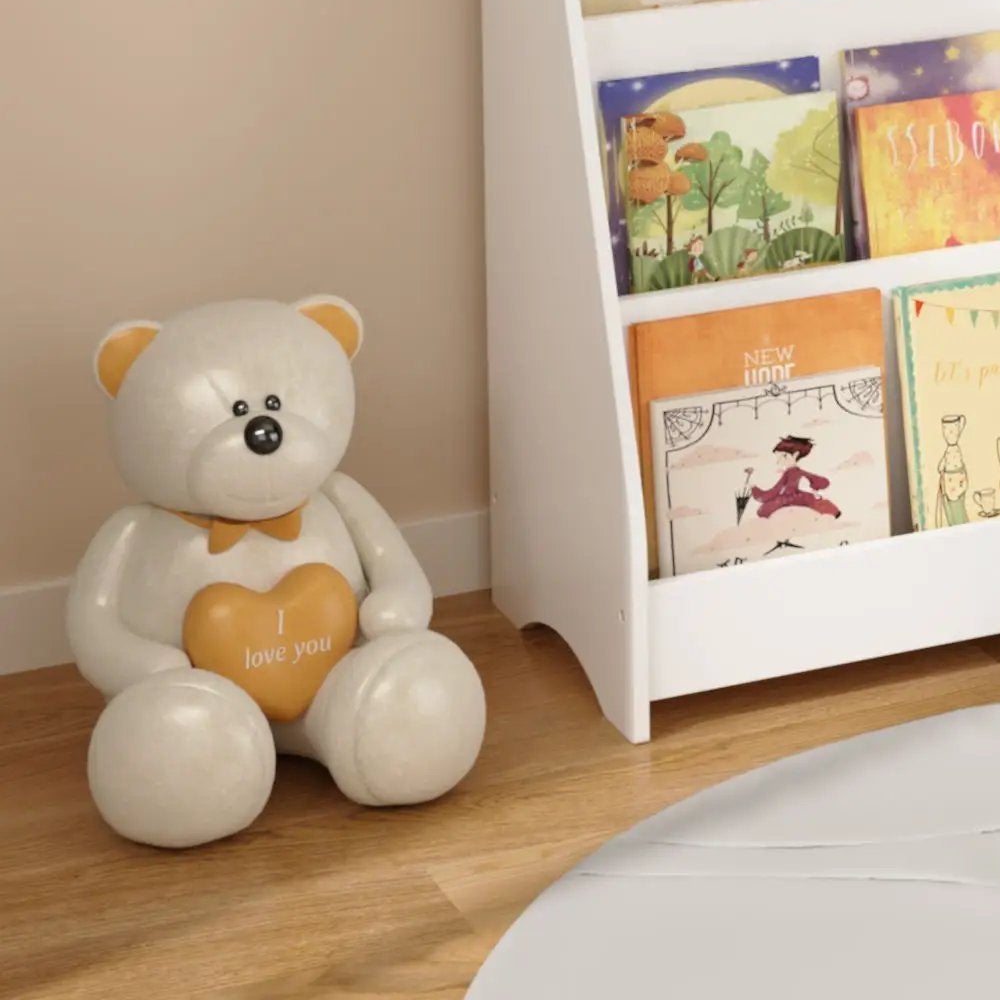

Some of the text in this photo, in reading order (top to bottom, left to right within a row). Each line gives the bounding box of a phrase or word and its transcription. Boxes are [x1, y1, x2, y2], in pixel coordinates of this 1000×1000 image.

[744, 344, 796, 368] NEW
[277, 609, 284, 635] I
[245, 635, 332, 670] love you
